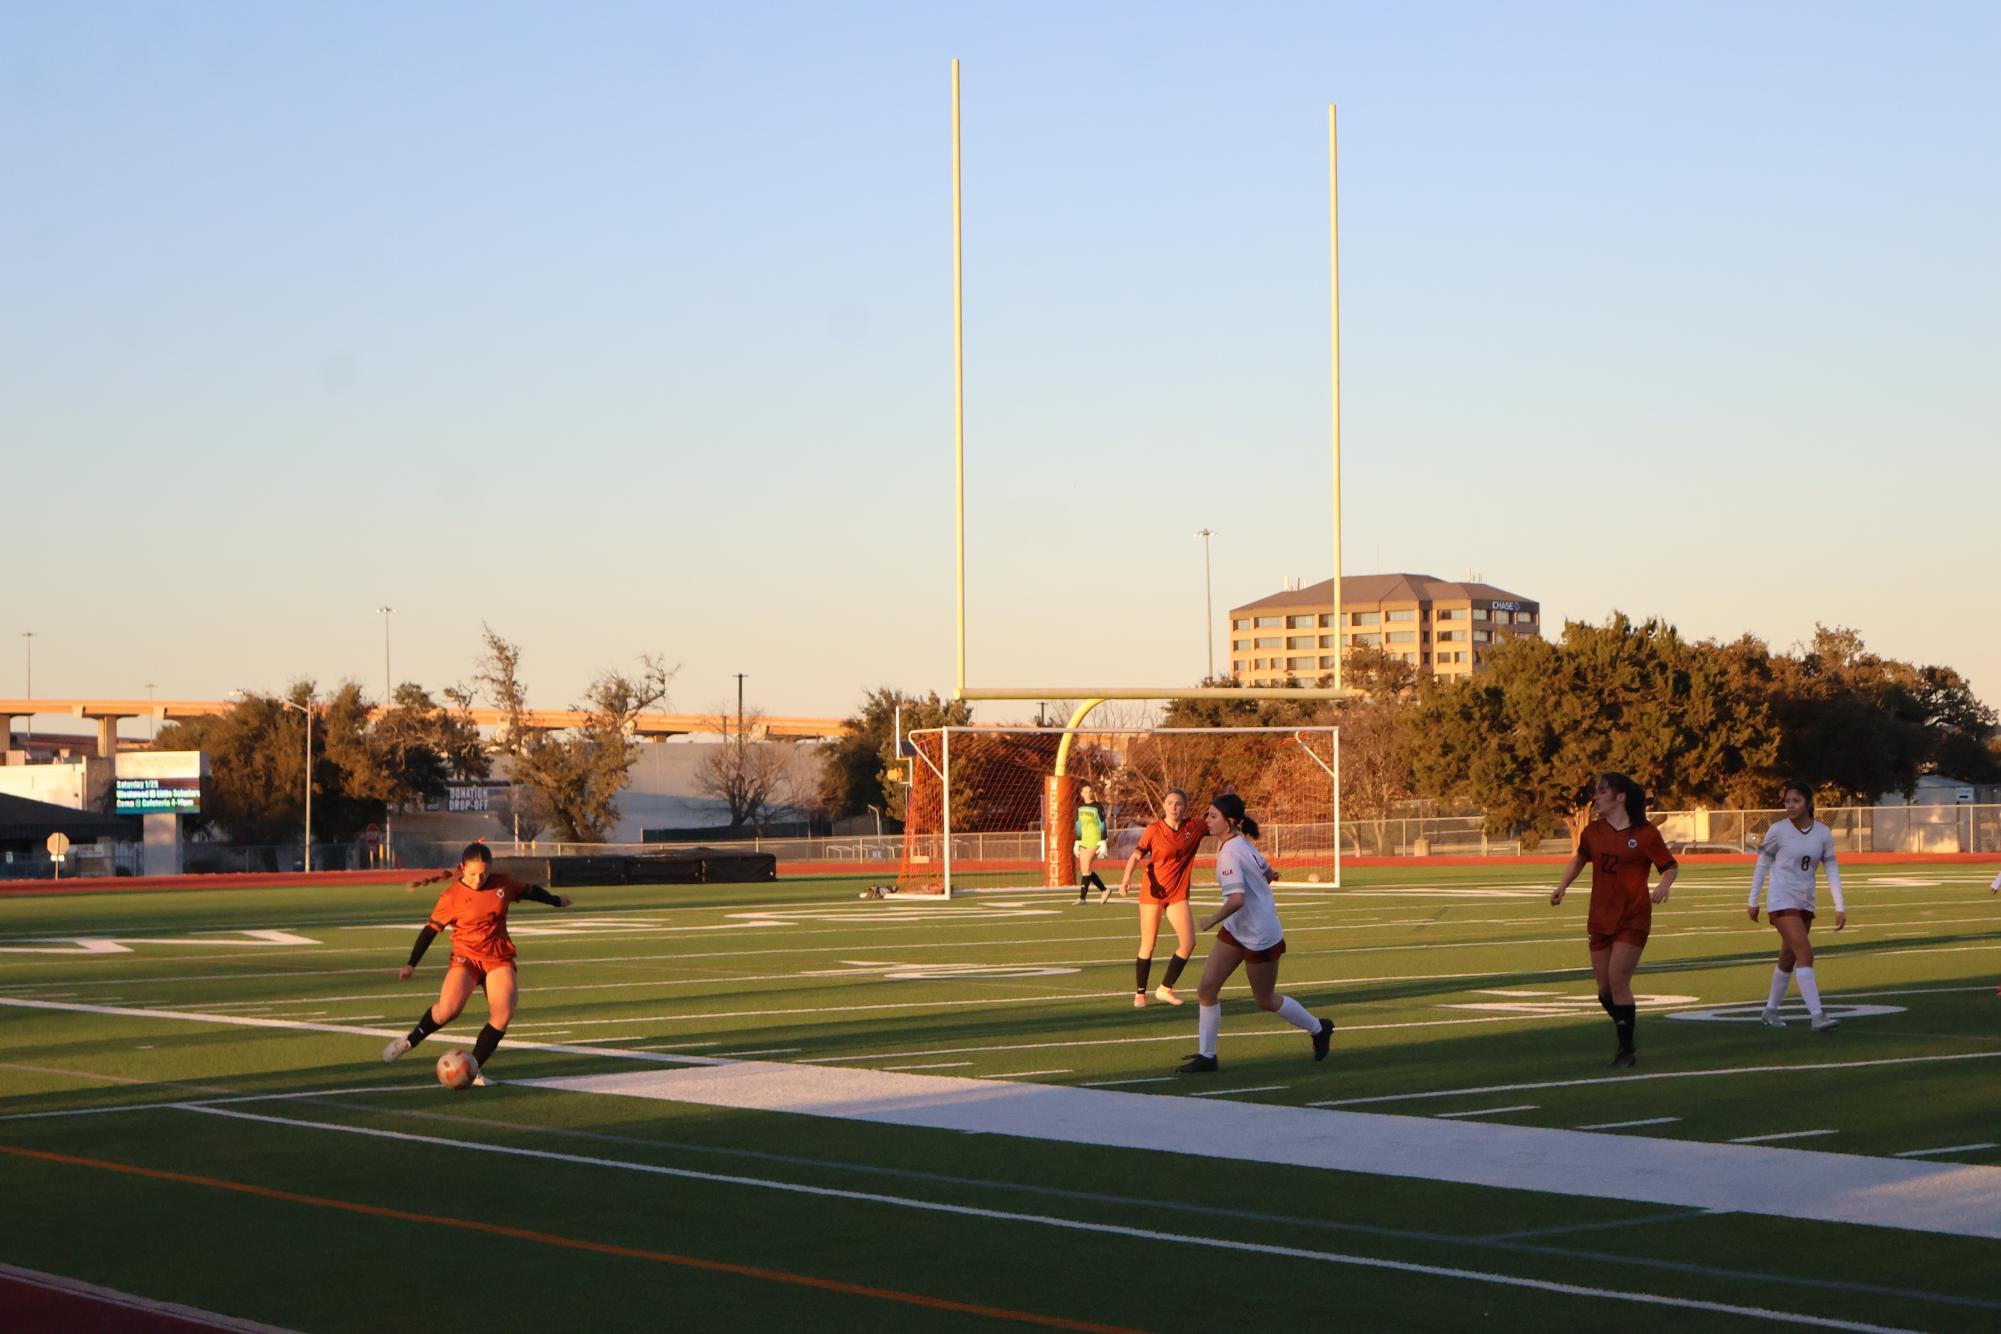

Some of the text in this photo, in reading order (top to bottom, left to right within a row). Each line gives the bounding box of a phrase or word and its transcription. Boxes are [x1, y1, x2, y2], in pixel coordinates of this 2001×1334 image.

[1492, 601, 1514, 609] CHASE
[116, 780, 144, 789] Saturday
[449, 787, 488, 799] DONATION
[449, 799, 488, 811] DROP-OFF
[1801, 855, 1811, 871] 8
